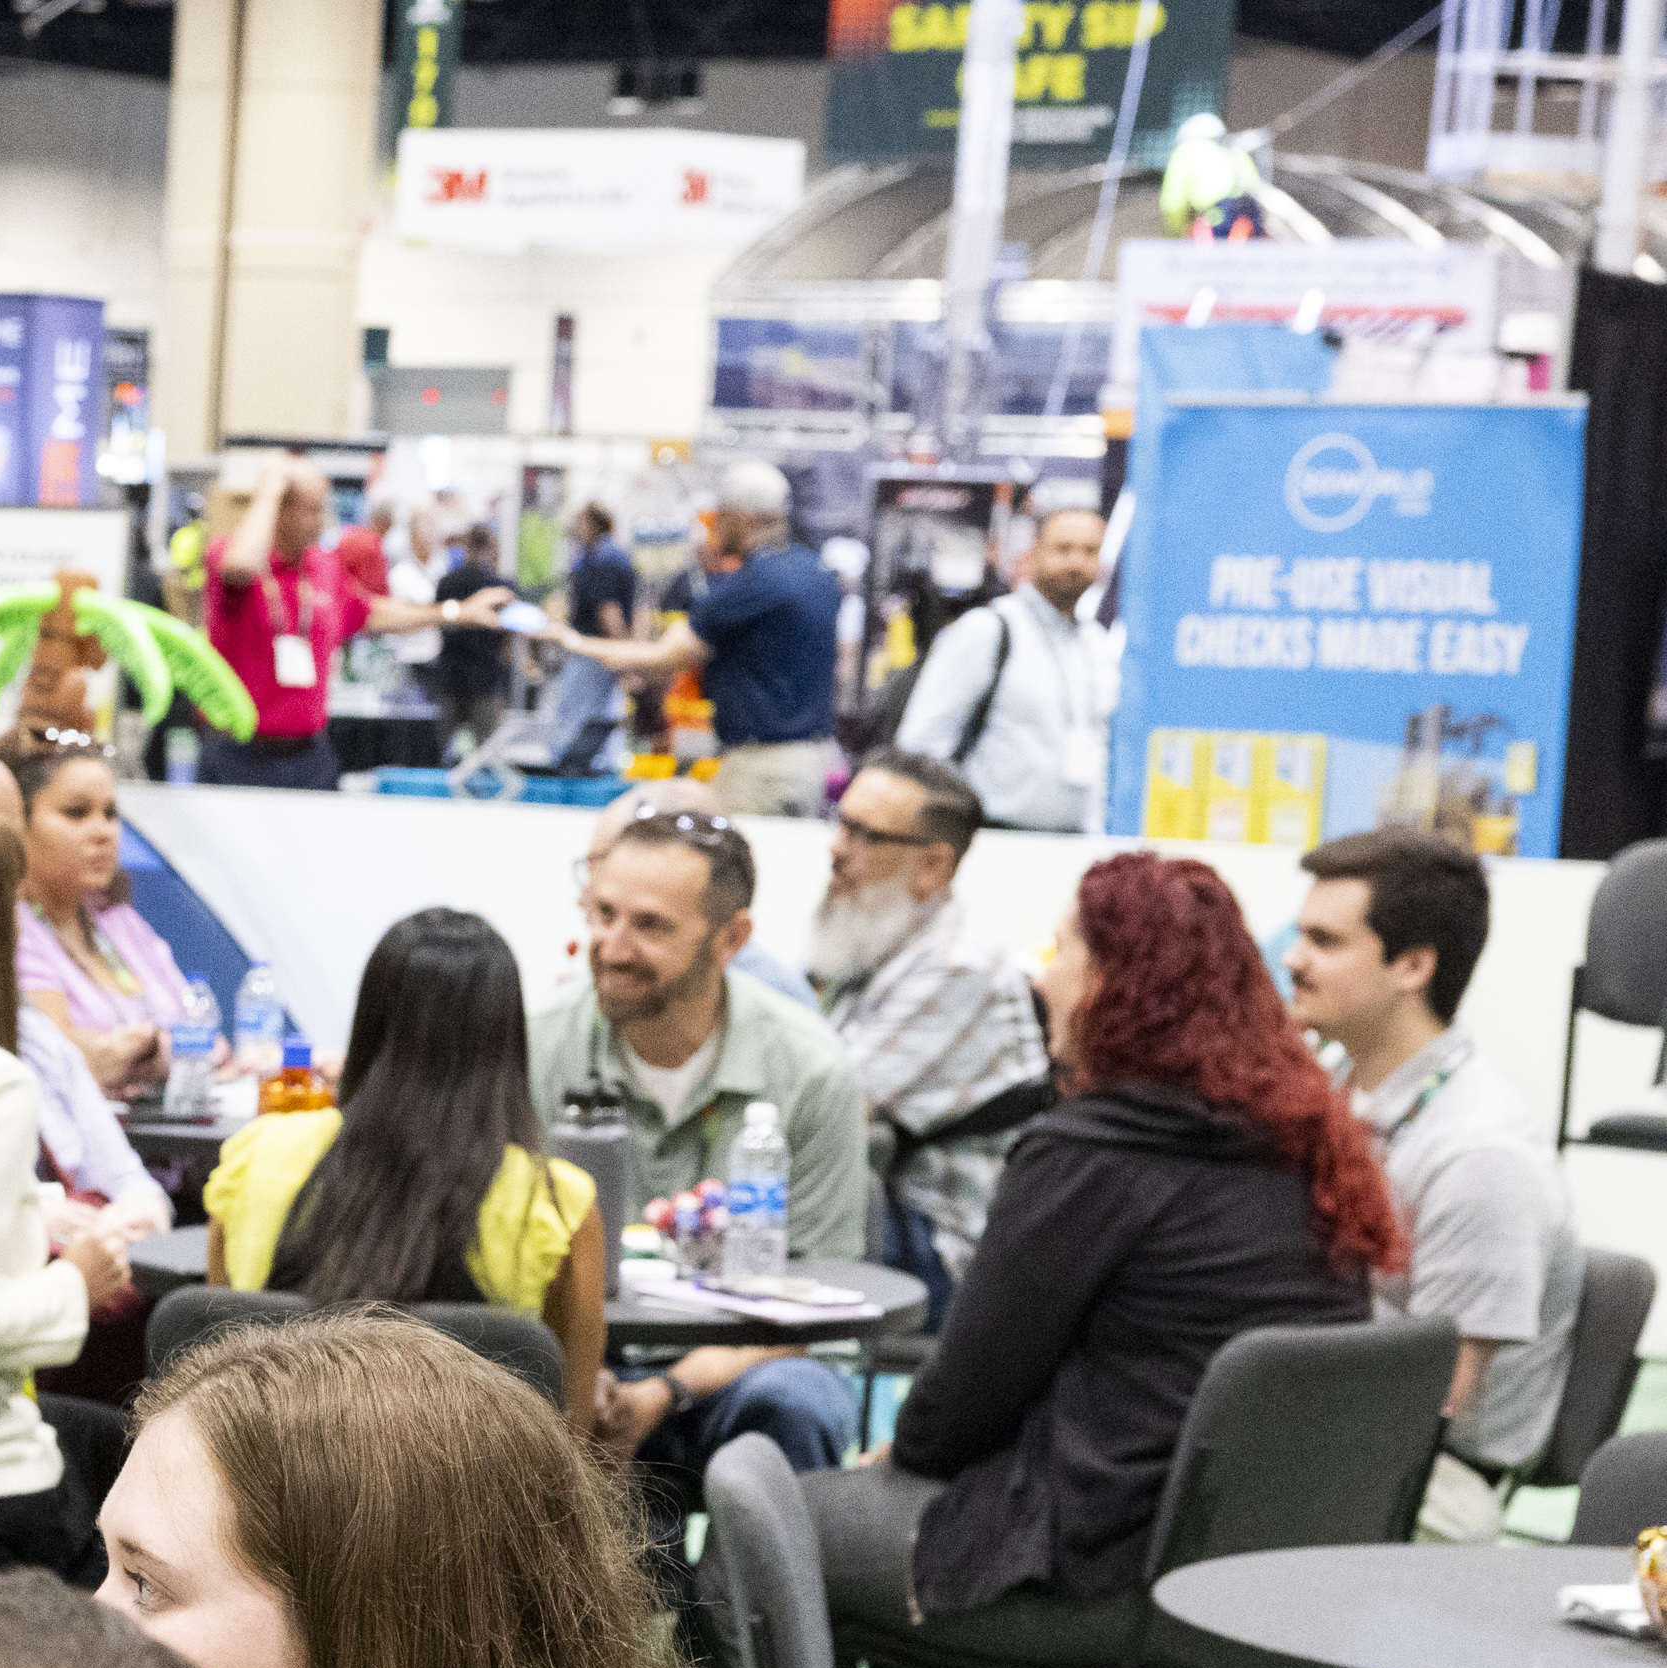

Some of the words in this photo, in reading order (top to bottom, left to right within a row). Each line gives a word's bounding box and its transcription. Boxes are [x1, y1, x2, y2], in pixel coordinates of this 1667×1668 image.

[427, 165, 489, 205] 3M
[1209, 554, 1362, 612] PRE-USE
[1369, 559, 1498, 616] VISUAL
[1175, 615, 1312, 670] CHECKS
[1319, 618, 1424, 674] MADE
[1430, 621, 1530, 676] EASY
